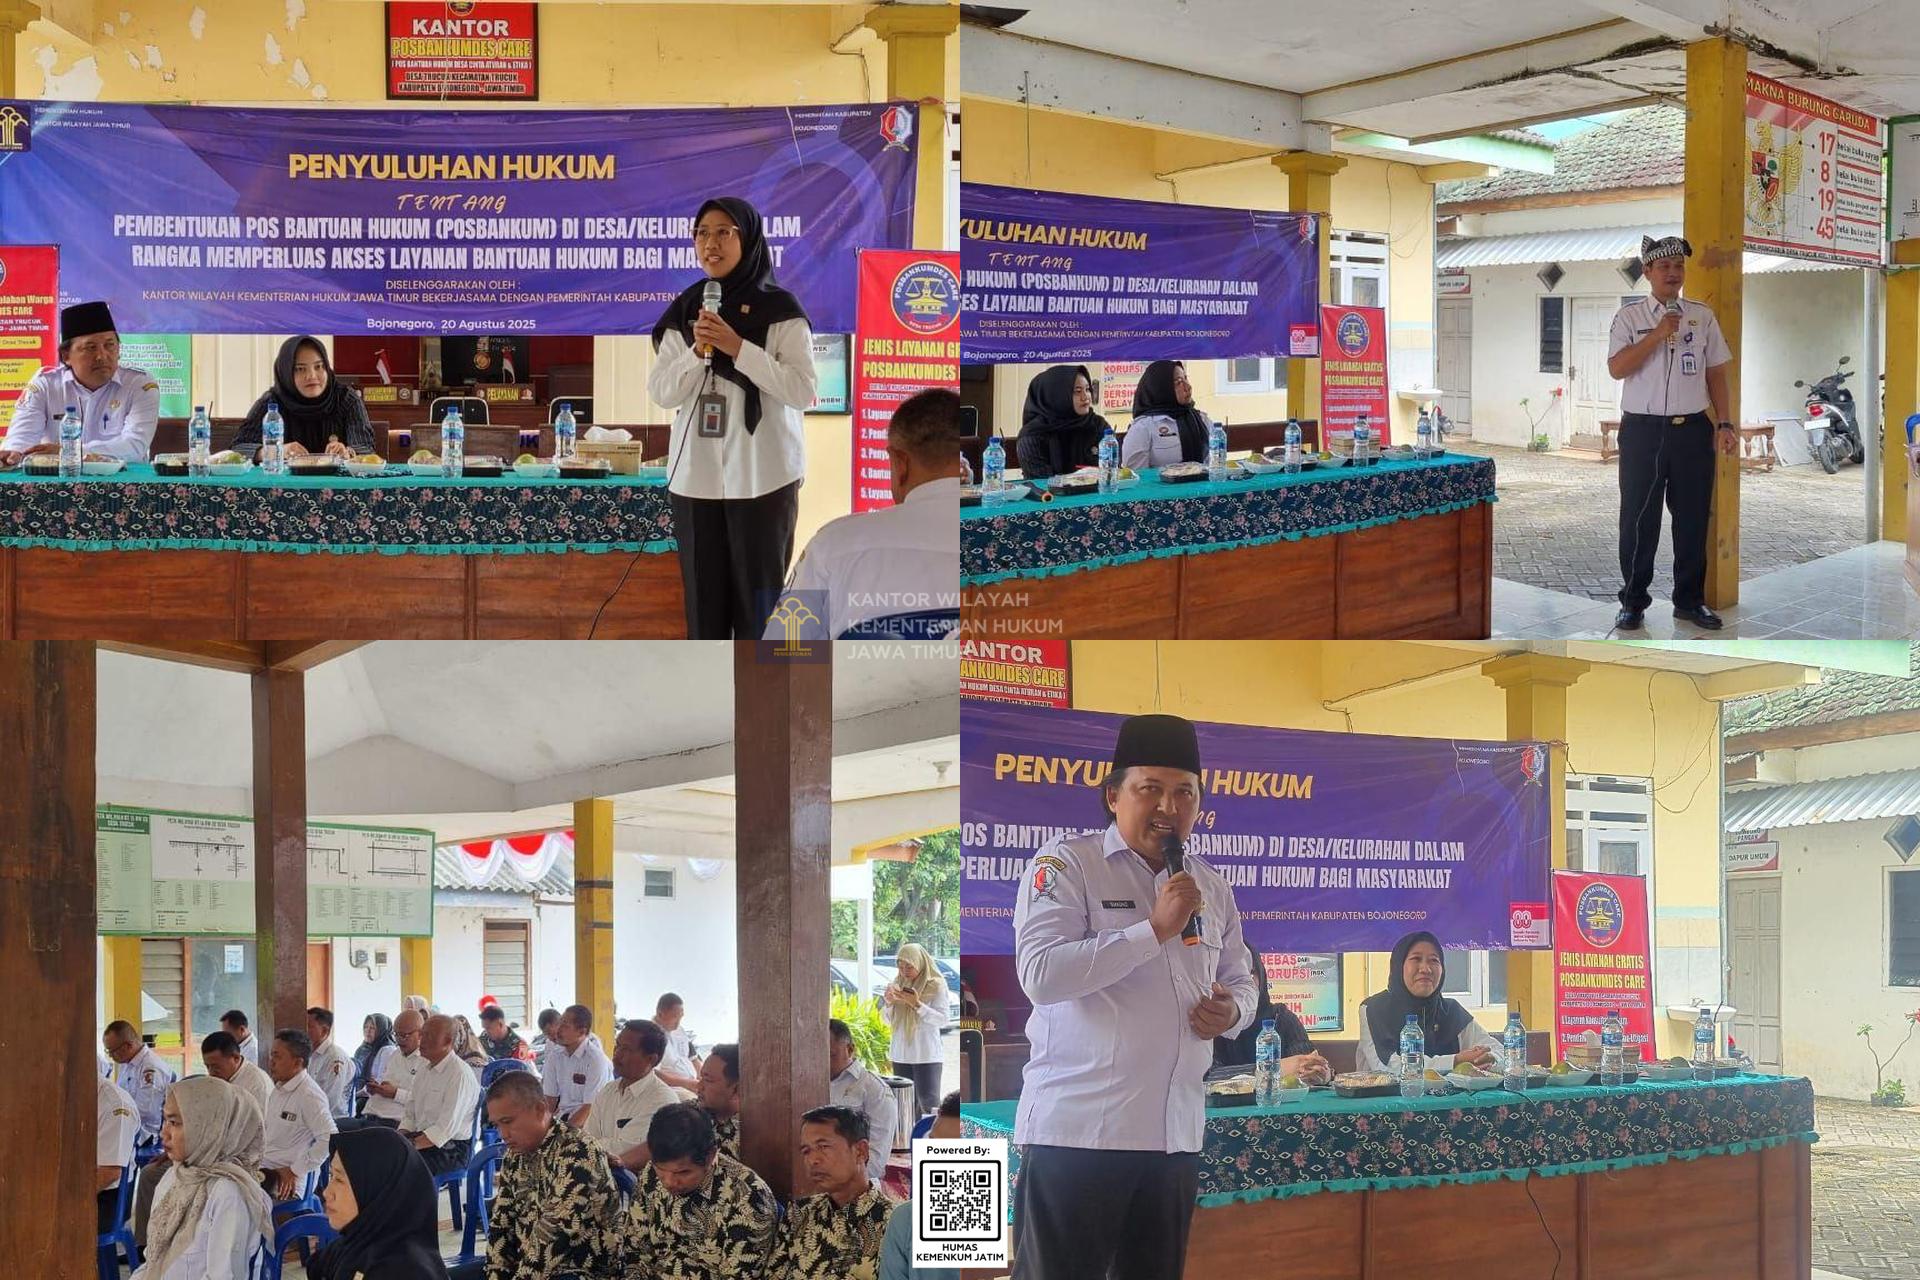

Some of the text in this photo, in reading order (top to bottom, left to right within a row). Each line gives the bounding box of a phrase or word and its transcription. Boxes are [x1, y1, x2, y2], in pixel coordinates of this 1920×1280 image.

[412, 19, 509, 36] KANTOR
[392, 38, 532, 58] POSBANKUMDES CARE
[406, 73, 422, 82] DESA
[451, 73, 490, 82] KECAMATAN
[490, 73, 518, 82] TRUCUK
[399, 84, 437, 92] KABUPATEN
[485, 84, 502, 92] JAWA
[835, 110, 872, 118] KABUPATEN
[1788, 92, 1830, 118] BURUNG
[1832, 106, 1870, 130] GARUDA
[1818, 131, 1836, 156] 17
[288, 154, 616, 180] PENYULUHAN HUKUM
[1820, 160, 1830, 182] 8
[1818, 188, 1835, 212] 19
[114, 214, 241, 238] PEMBENTUKAN
[246, 216, 279, 239] POS
[284, 216, 362, 240] BANTUAN
[368, 217, 430, 240] HUKUM
[435, 217, 557, 240] (POSBANKUM)
[562, 218, 580, 240] DI
[1816, 216, 1835, 240] 45
[1069, 228, 1147, 250] HUKUM
[132, 245, 662, 270] RANGKA MEMPERLUAS AKSES LAYANAN BANTUAN HUKUM BAGI
[385, 280, 516, 290] DISELENGGARAKAN OLEH
[894, 264, 948, 299] POSBANKUMDES
[966, 270, 1258, 296] HUKUM (POSBANKUM) DI DESA/KELURAHAN DALAM
[142, 290, 675, 303] KANTOR WILAYAH KEMENTERIAN HUKUM JAWA TIMUR BEKERJASAMA DENGAN PEMERINTAH KABUPATEN
[983, 294, 1249, 316] LAYANAN BANTUAN HUKUM BAGI MASYARAKAT
[367, 318, 536, 330] Bojonegoro, 20 Agustus 2025
[979, 320, 1080, 329] DISELENGGARAKAN OLEH
[981, 330, 1006, 338] TIMUR
[1144, 330, 1184, 338] KABUPATEN
[1186, 330, 1230, 338] BOJONEGORO
[862, 338, 945, 358] JENIS LAYANAN
[964, 350, 1092, 360] Bojonegoro, 20 Agustus 2025
[862, 362, 956, 382] POSBANKUMDES
[486, 388, 519, 401] PELAYANAN
[1032, 667, 1066, 688] CARE
[1212, 769, 1314, 799] HUKUM
[1269, 836, 1284, 858] DI
[1288, 836, 1410, 861] DESA/KELURAHAN
[1414, 842, 1464, 862] DALAM
[1262, 866, 1315, 888] HUKUM
[1320, 867, 1351, 888] BAGI
[1356, 868, 1452, 889] MASYARAKAT
[1252, 910, 1426, 920] PEMERINTAH KABUPATEN BOJONEGORO
[1560, 952, 1644, 970] JENIS LAYANAN GRATIS
[1560, 973, 1646, 989] POSBANKUMDES CARE
